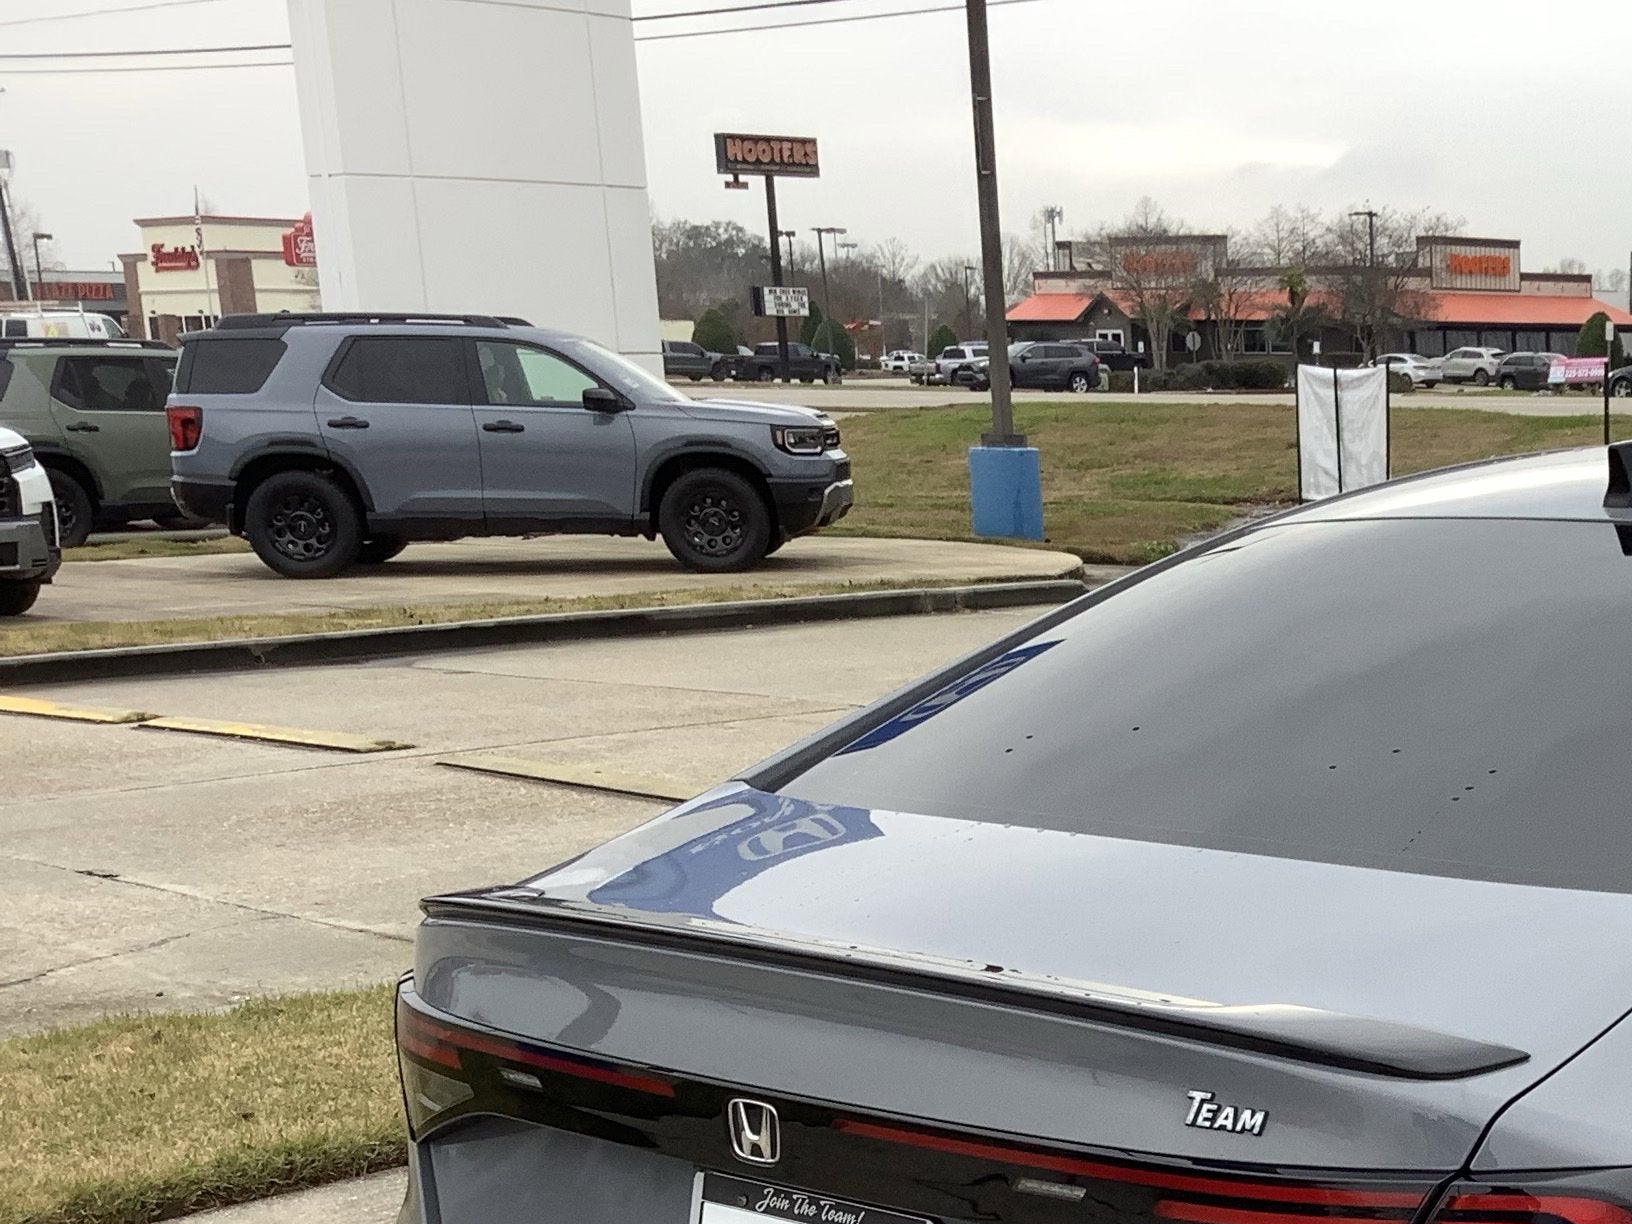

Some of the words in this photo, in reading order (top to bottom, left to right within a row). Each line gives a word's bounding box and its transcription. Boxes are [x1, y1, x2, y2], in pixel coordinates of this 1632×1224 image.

[726, 138, 817, 165] HOOTERS
[78, 282, 114, 300] PIZZA
[755, 1187, 791, 1213] Join
[792, 1194, 817, 1217] The
